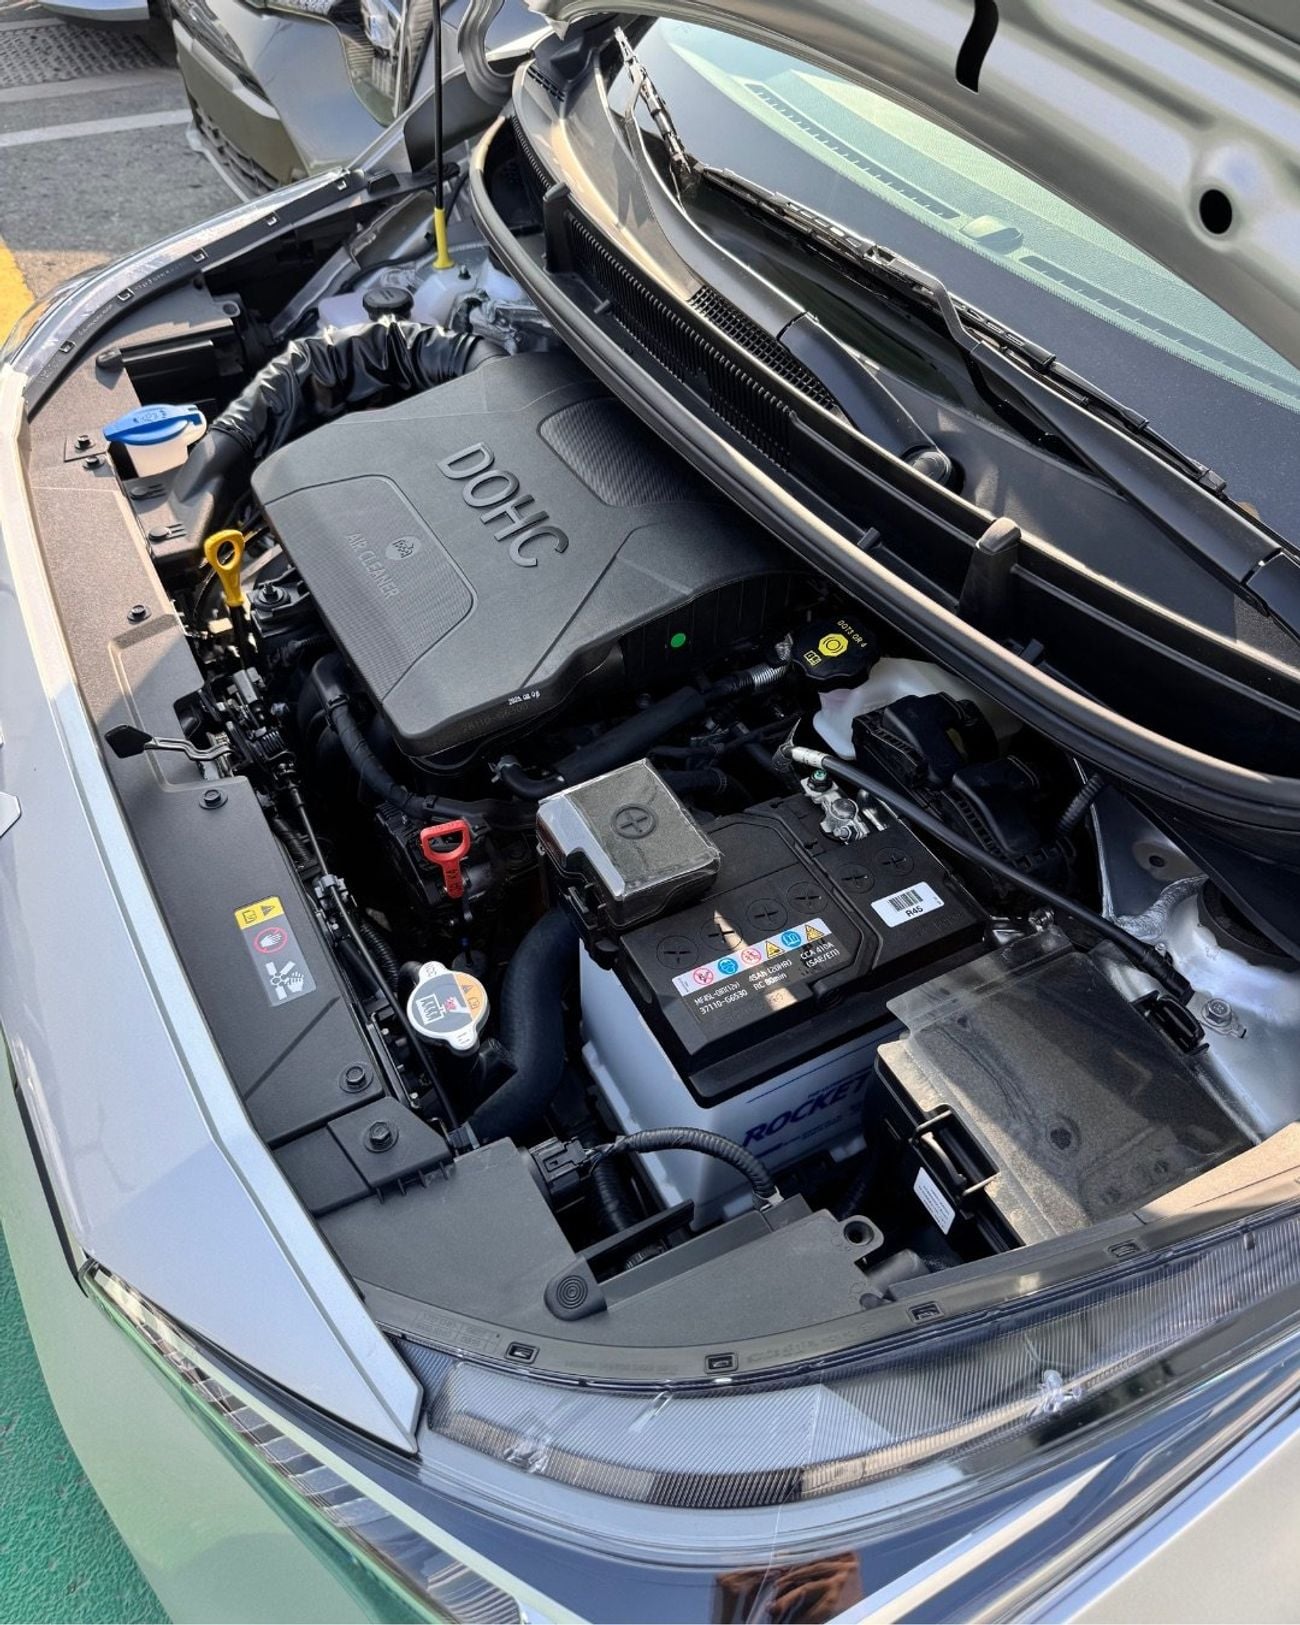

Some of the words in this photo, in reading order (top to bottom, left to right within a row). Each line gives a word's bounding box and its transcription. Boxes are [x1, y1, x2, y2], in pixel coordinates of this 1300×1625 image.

[436, 442, 569, 568] DOHC
[344, 533, 368, 553] AIR
[358, 550, 400, 600] CLEANER
[852, 633, 863, 643] OR
[905, 906, 924, 917] R45
[800, 949, 815, 960] CCA
[753, 979, 765, 992] RC
[699, 989, 748, 1015] 37110-G6530
[742, 1070, 873, 1148] ROCKET
